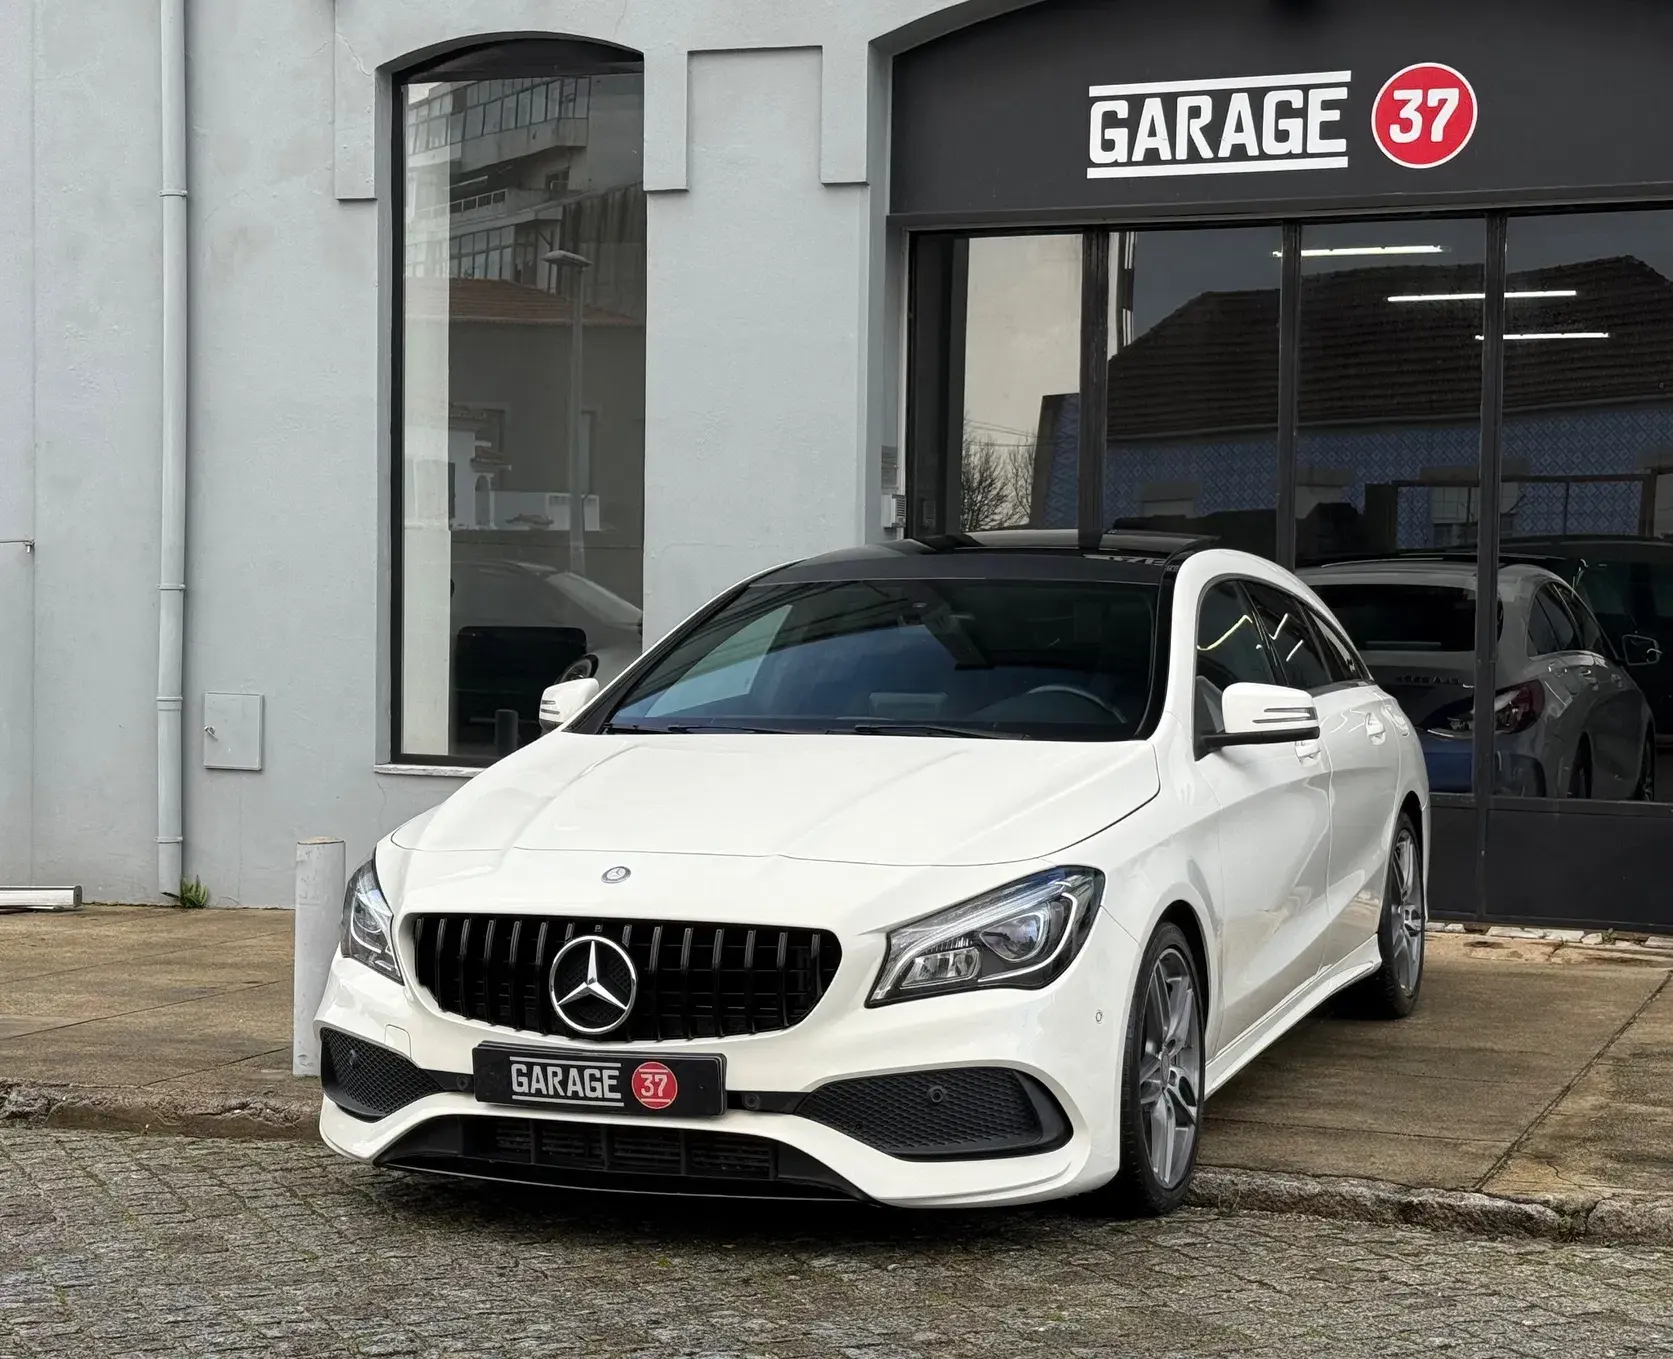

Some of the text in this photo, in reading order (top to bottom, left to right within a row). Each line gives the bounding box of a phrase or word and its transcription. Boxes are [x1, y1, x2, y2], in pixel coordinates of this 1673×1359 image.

[1089, 86, 1460, 164] GARAGE 37
[511, 1063, 668, 1099] GARAGE 37
